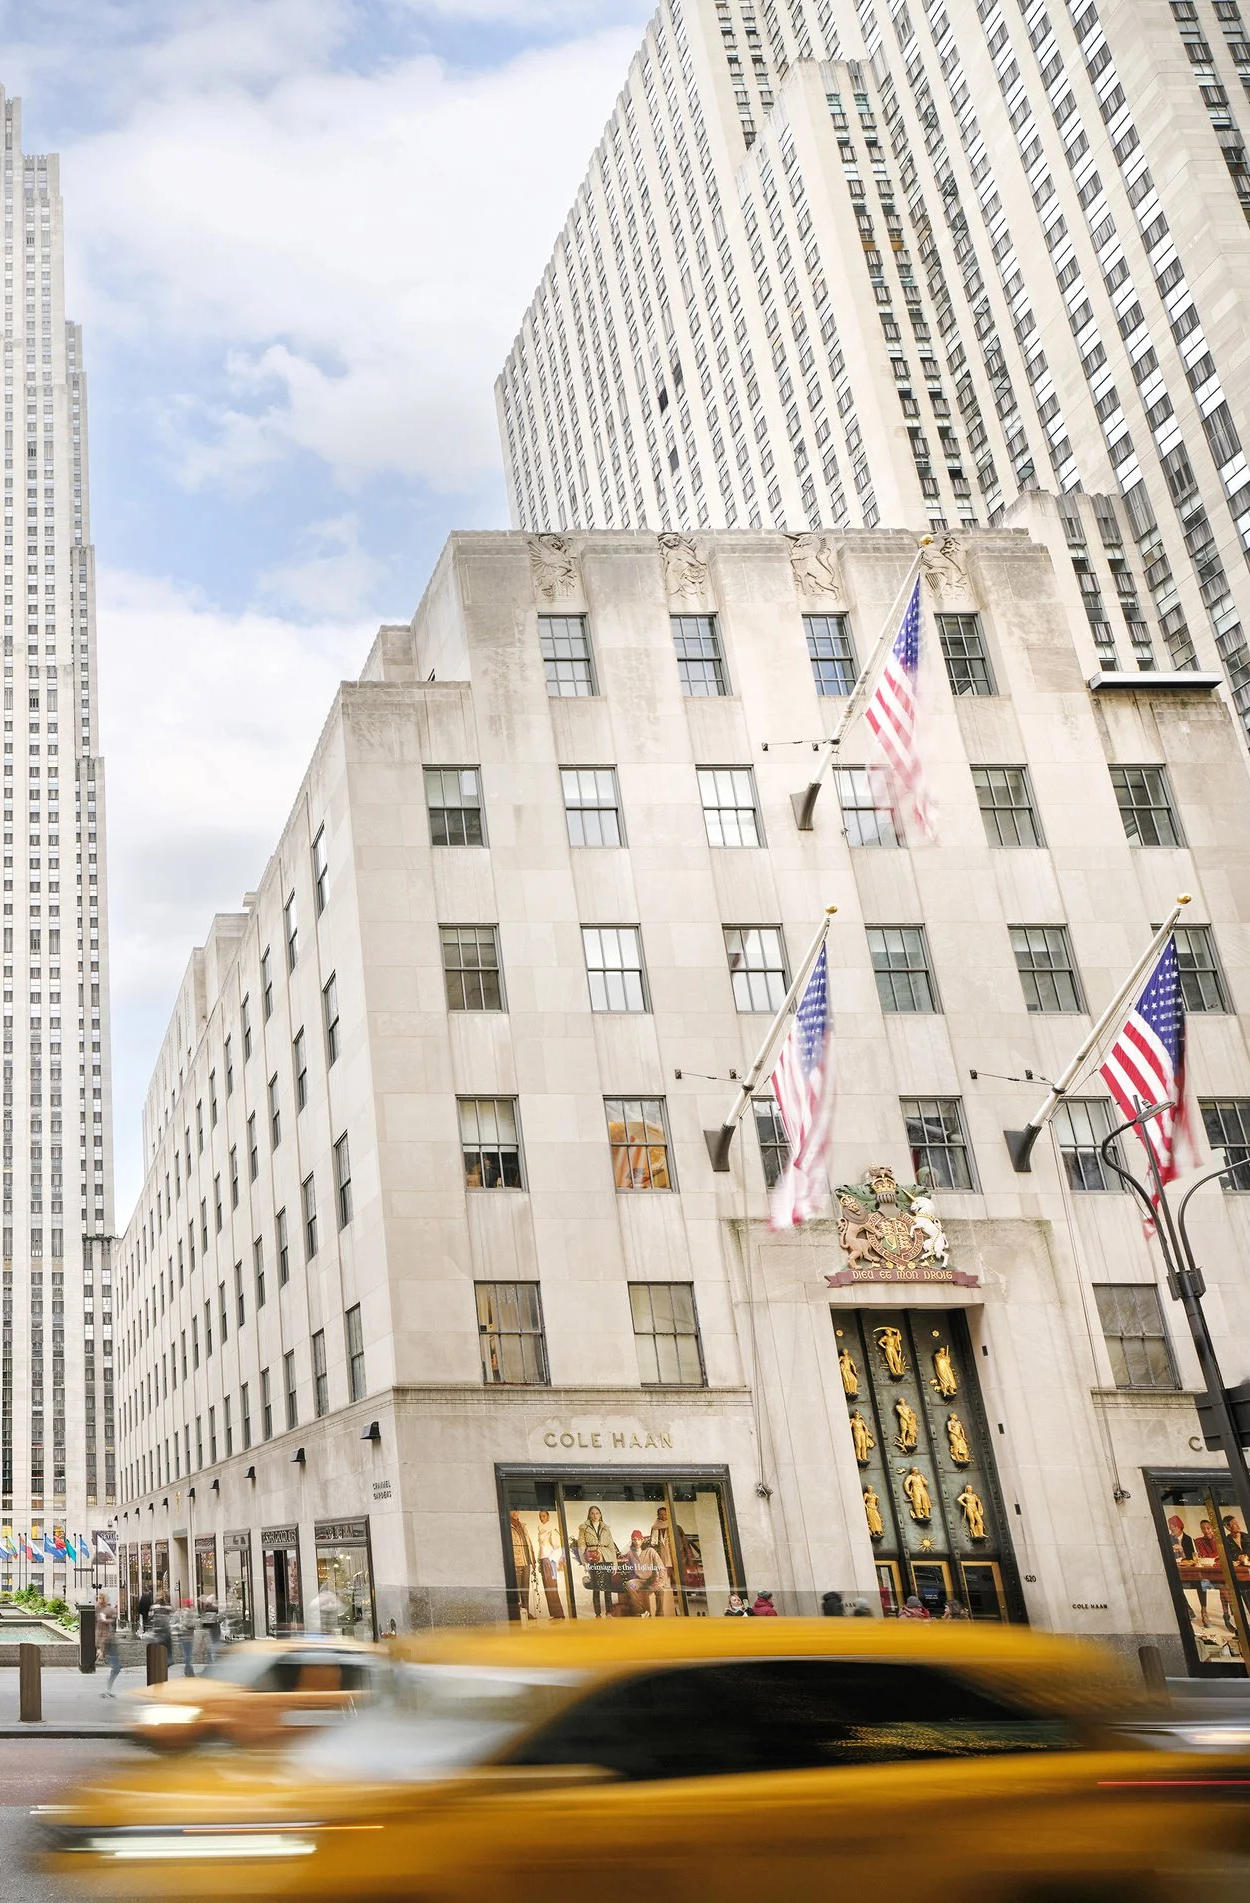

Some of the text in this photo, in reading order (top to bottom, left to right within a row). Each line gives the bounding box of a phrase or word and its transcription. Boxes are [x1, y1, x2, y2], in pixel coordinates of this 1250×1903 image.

[852, 1270, 953, 1280] DIEU ET MON DROIT
[544, 1432, 673, 1449] COLE HAAN
[1025, 1574, 1037, 1583] 620
